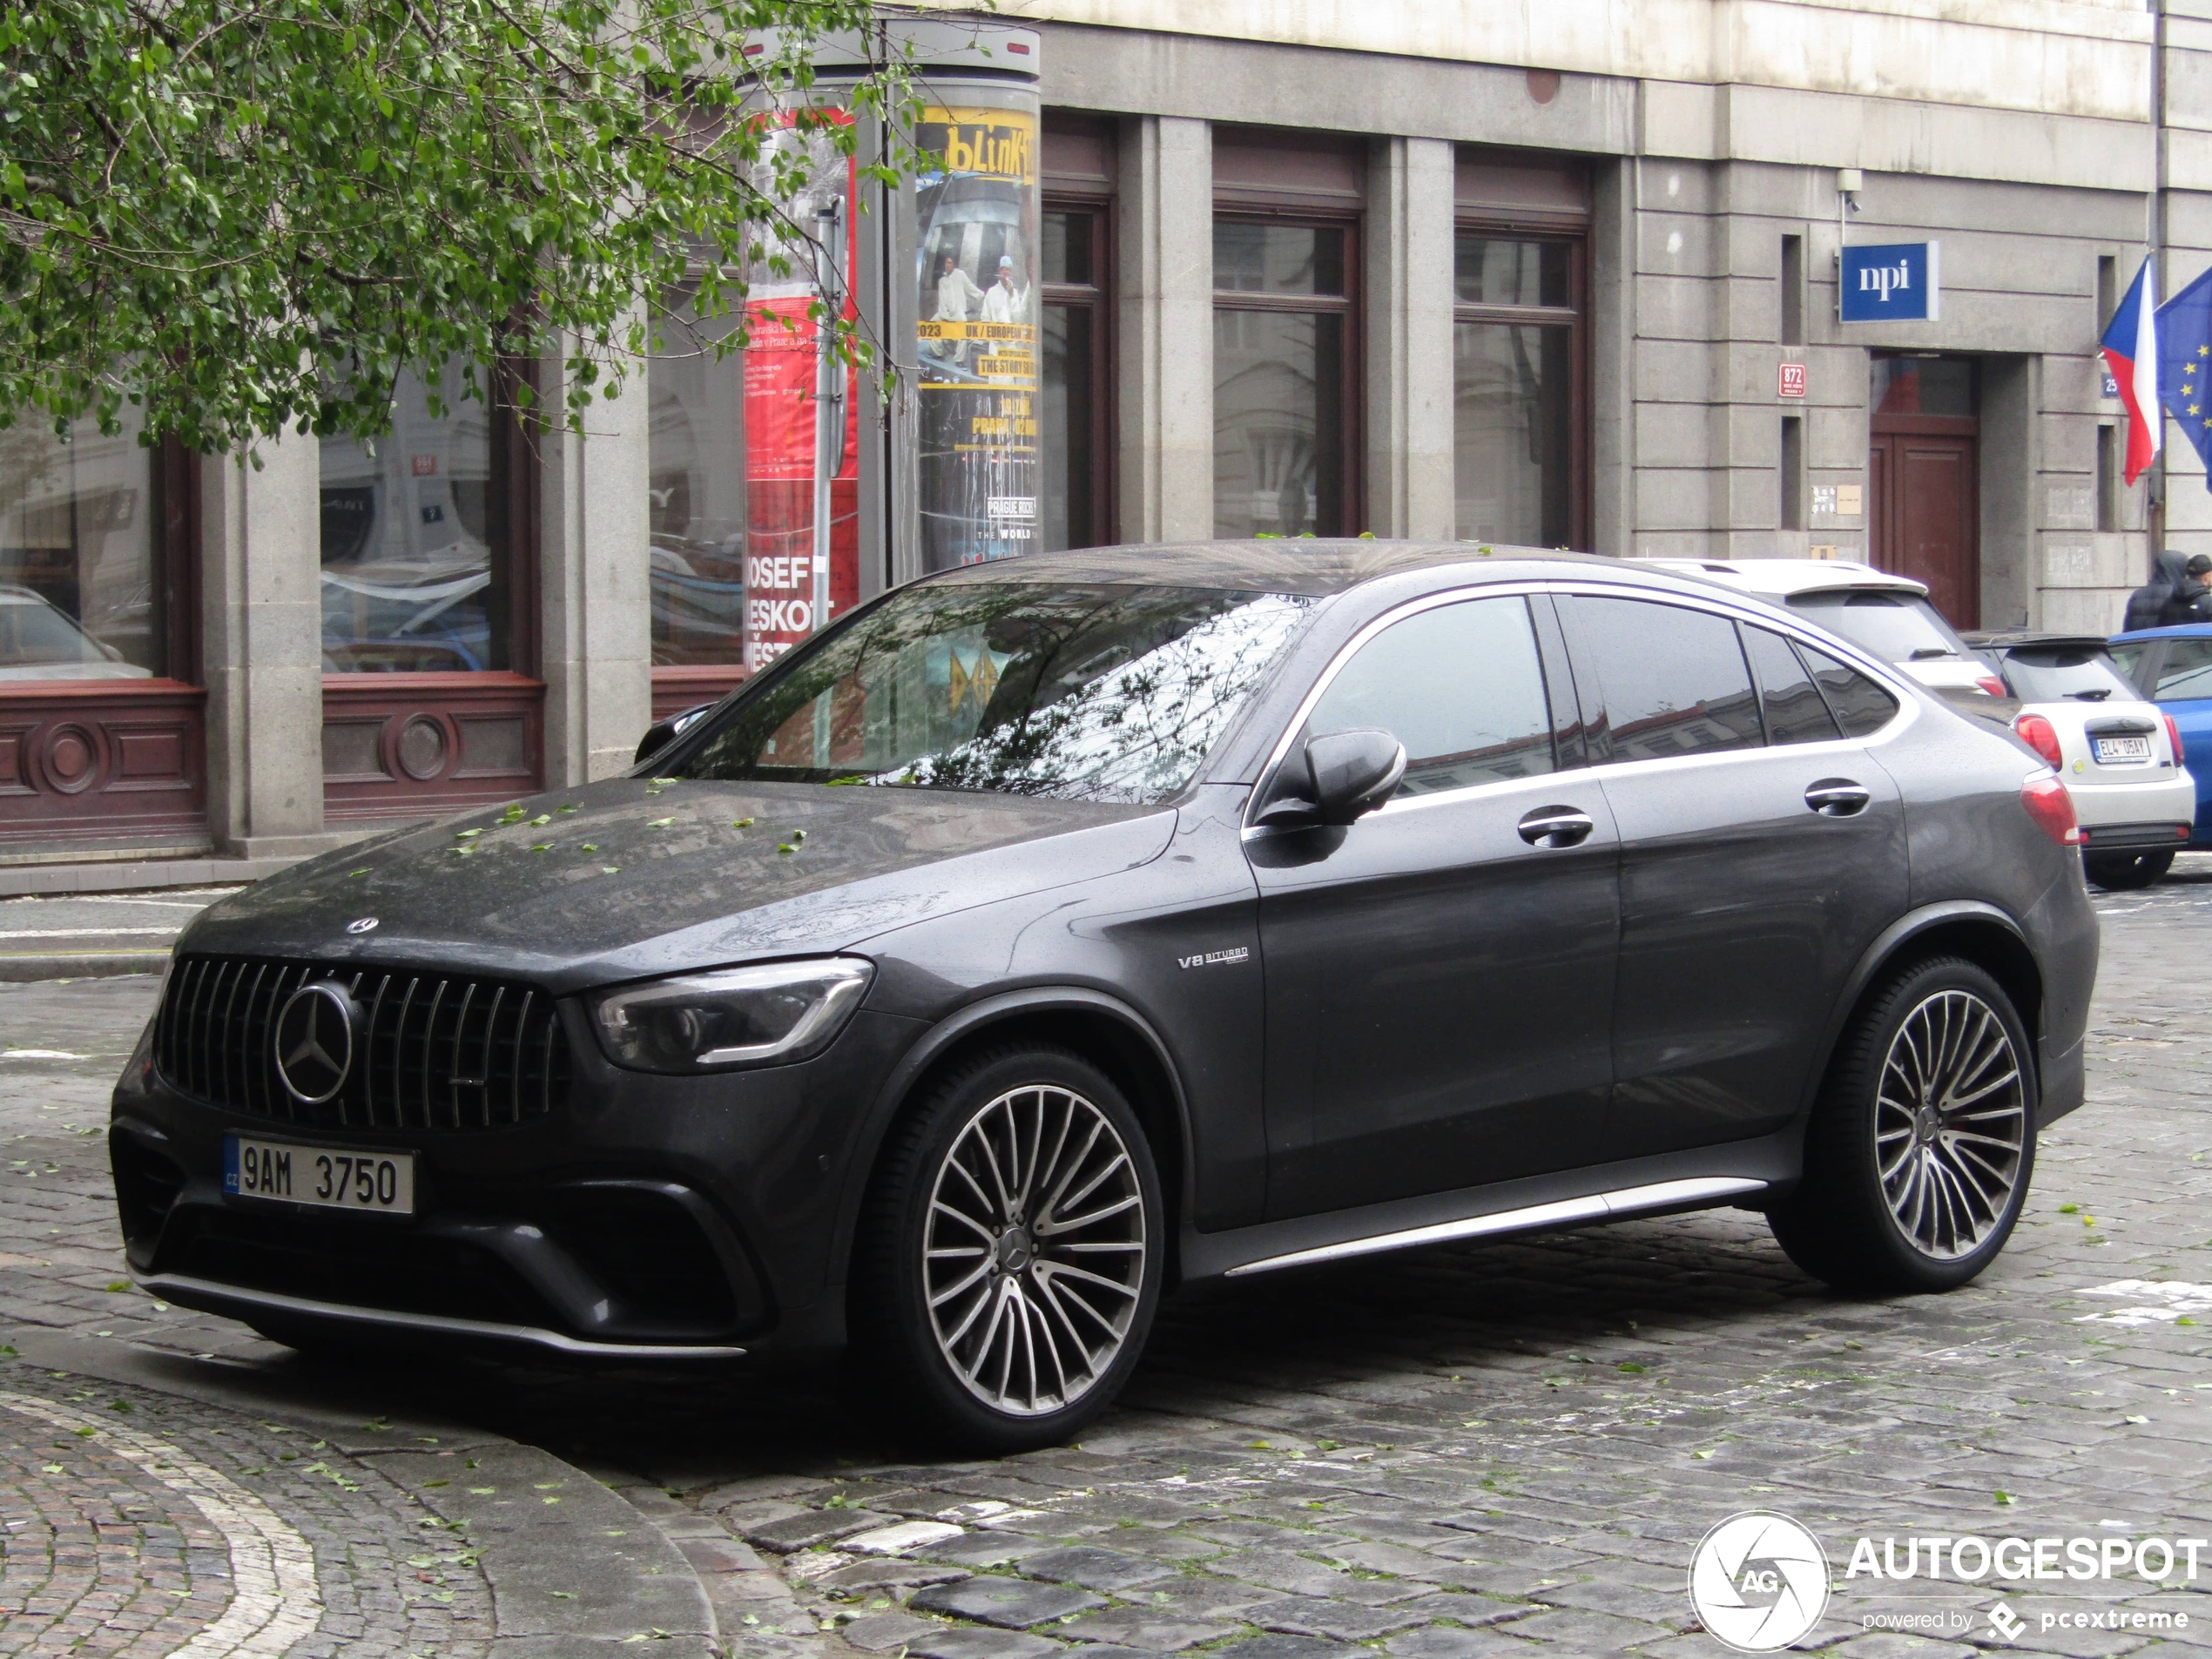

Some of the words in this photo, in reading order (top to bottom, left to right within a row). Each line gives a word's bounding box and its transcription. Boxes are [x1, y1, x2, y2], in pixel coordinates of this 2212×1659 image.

[1859, 259, 1910, 301] npi
[917, 324, 941, 337] 023
[966, 325, 977, 337] UK
[981, 359, 997, 373] THE
[1784, 368, 1802, 383] 872
[988, 501, 1018, 515] PRAGUE
[1001, 529, 1031, 539] WORLD
[1178, 954, 1203, 969] V8
[1205, 947, 1248, 961] BITURBO
[226, 1172, 238, 1186] CZ
[245, 1146, 292, 1196] 9AM
[316, 1154, 396, 1204] 3750
